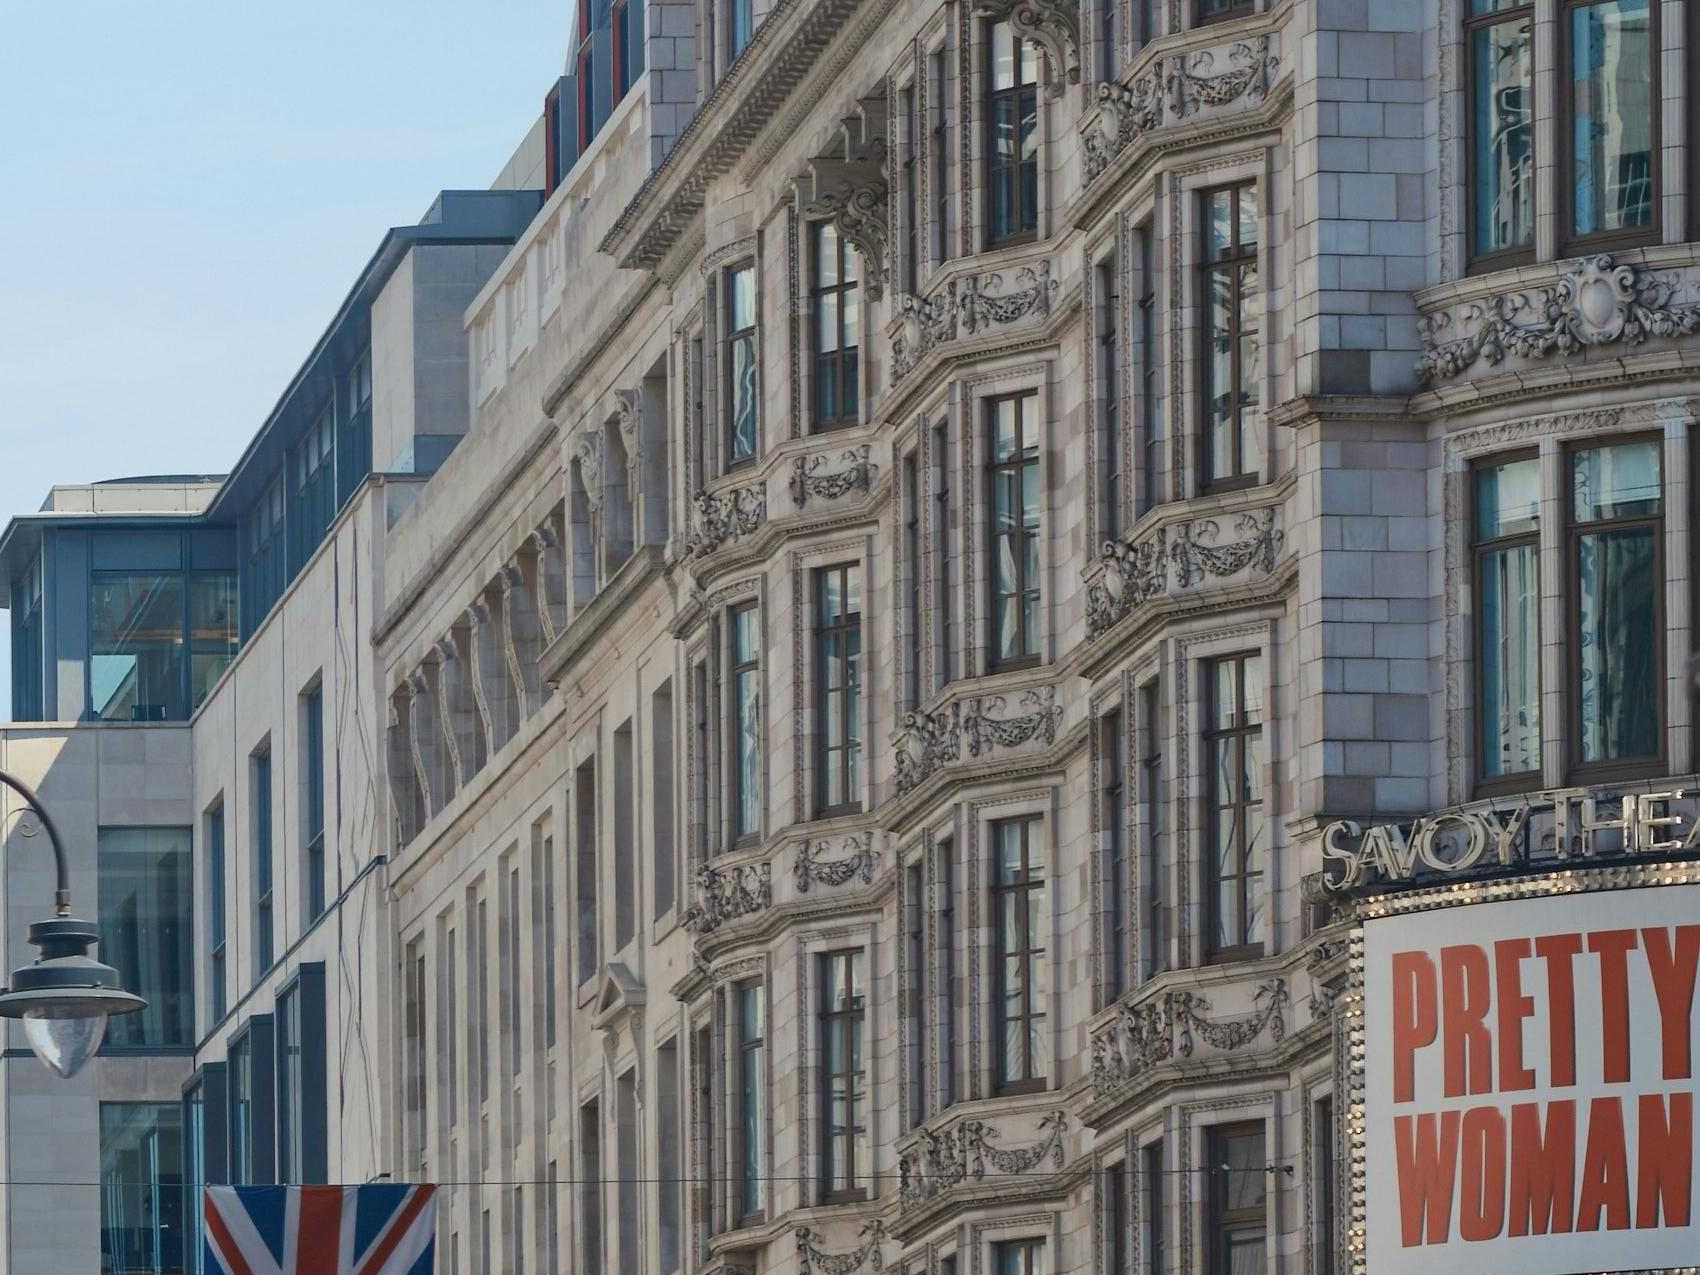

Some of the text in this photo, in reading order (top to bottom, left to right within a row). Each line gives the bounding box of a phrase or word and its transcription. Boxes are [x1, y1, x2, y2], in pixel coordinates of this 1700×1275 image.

[1321, 804, 1530, 891] SAVOY
[1392, 924, 1700, 1103] PRETTY
[1393, 1092, 1693, 1248] WOMAN
